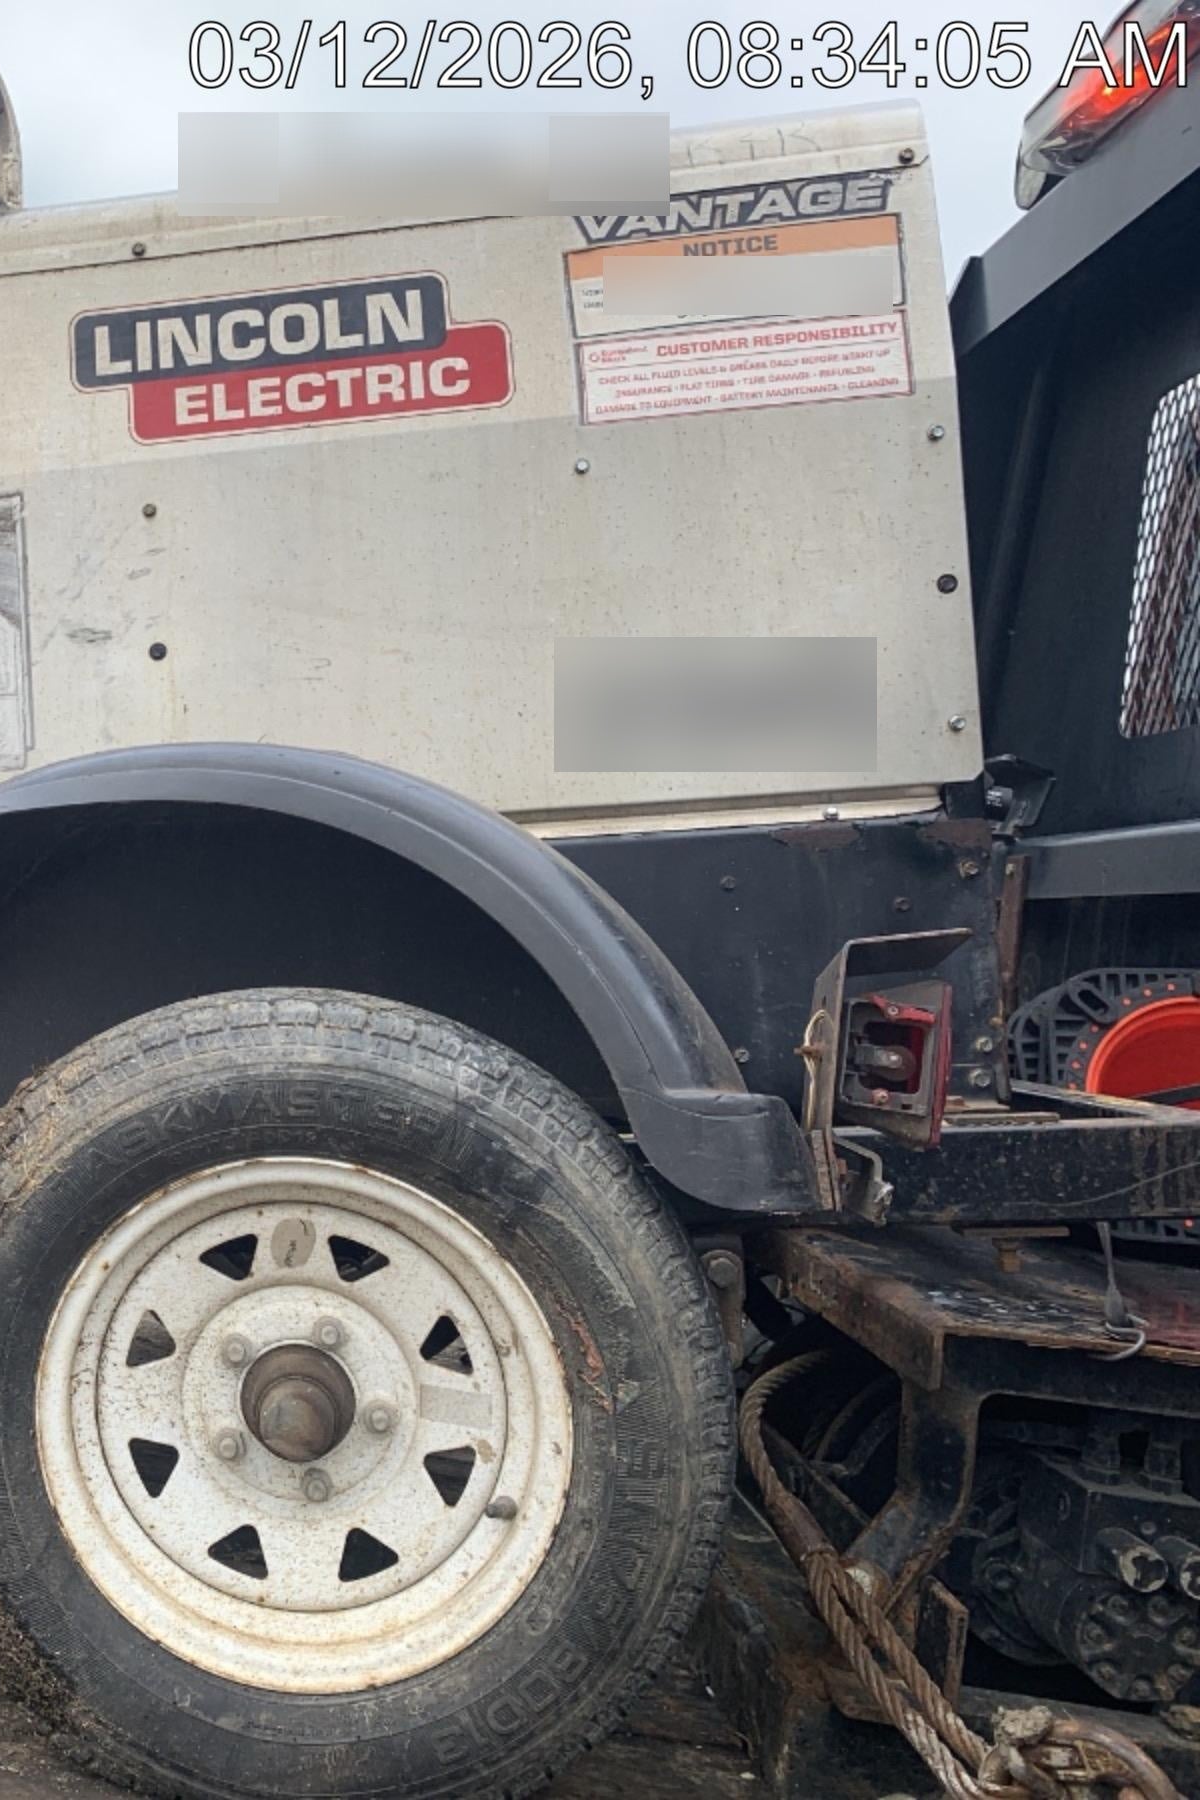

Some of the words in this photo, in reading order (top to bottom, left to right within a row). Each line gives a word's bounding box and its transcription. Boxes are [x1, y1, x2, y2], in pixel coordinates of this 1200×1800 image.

[573, 177, 892, 243] VANTAGE
[682, 233, 779, 257] NOTICE
[93, 288, 426, 378] LINCOLN
[656, 337, 749, 357] CUSTOMER
[753, 322, 897, 347] RESPONSIBILITY
[598, 376, 630, 386] CHECK
[633, 373, 649, 382] ALL
[652, 370, 681, 380] FLUID
[683, 366, 717, 377] LEVELS
[770, 358, 798, 368] DAILY
[174, 356, 472, 427] ELECTRIC
[654, 396, 711, 409] EQUIPMENT
